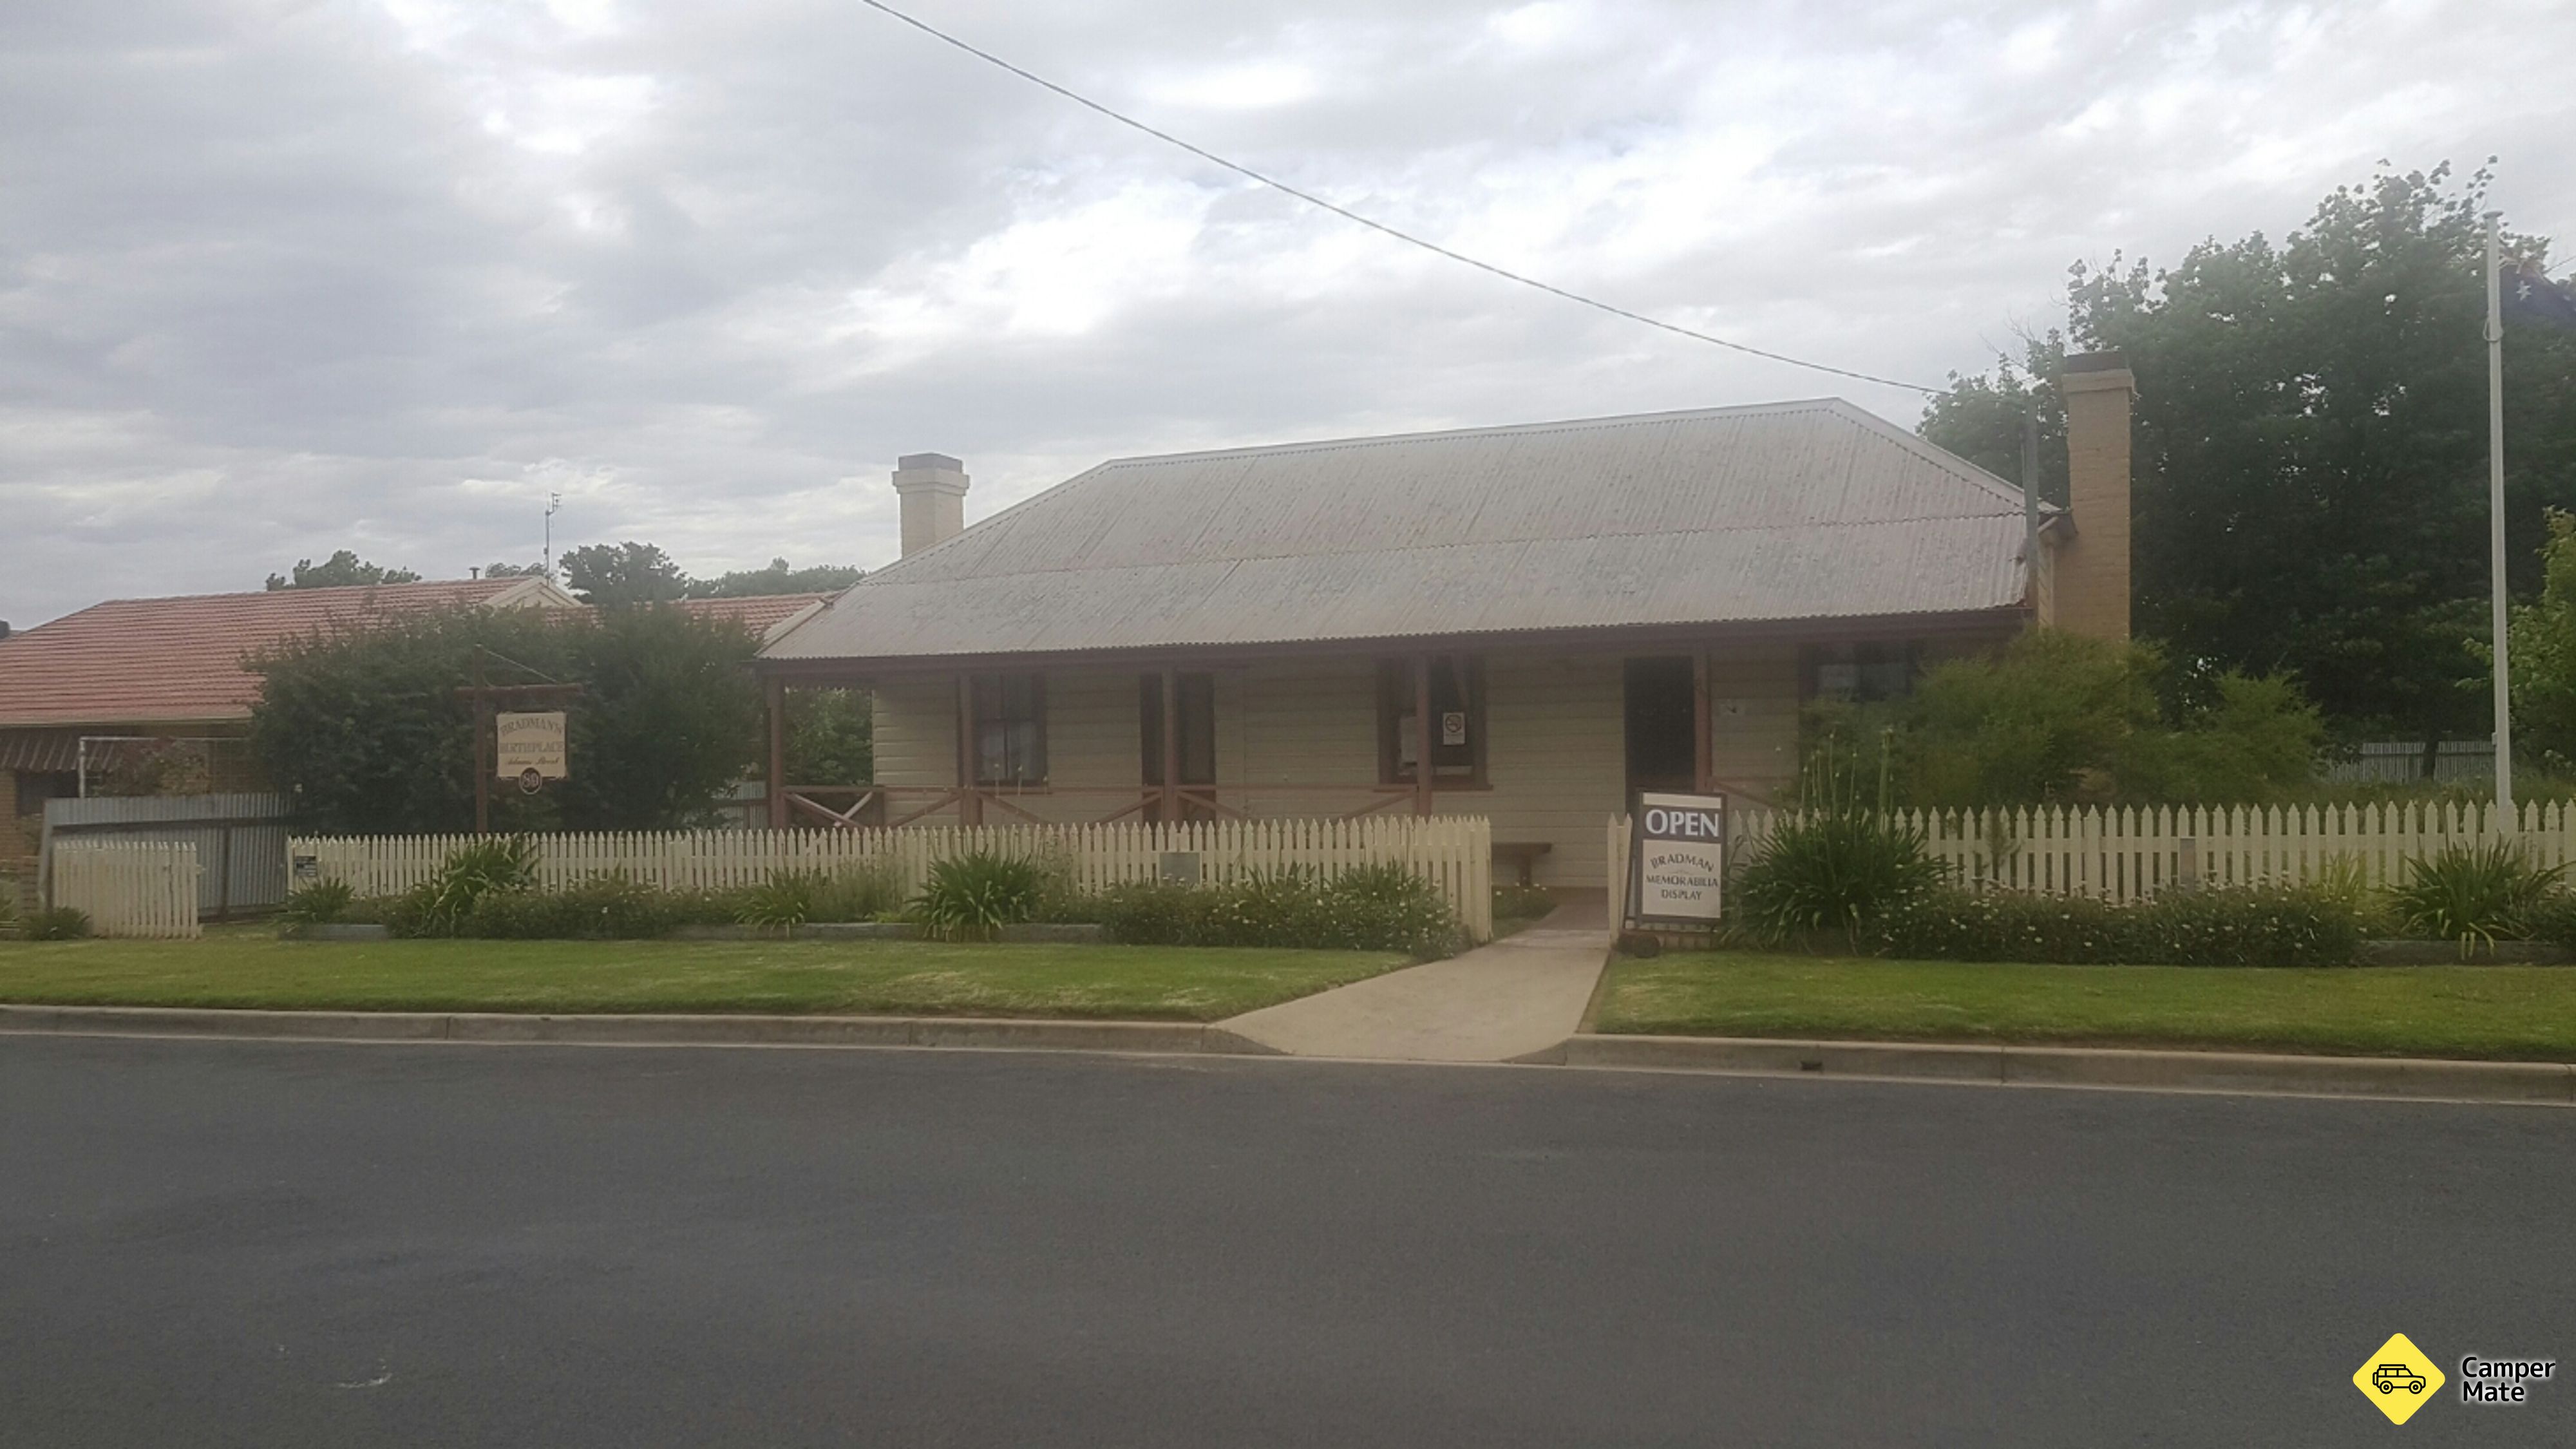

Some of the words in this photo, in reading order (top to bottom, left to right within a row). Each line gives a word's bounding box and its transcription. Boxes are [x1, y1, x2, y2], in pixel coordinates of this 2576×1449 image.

[1645, 809, 1719, 837] OPEN
[1650, 853, 1714, 872] BRADMAN
[1646, 875, 1718, 887] MEMORABILIA
[1661, 889, 1702, 900] DISPLAY
